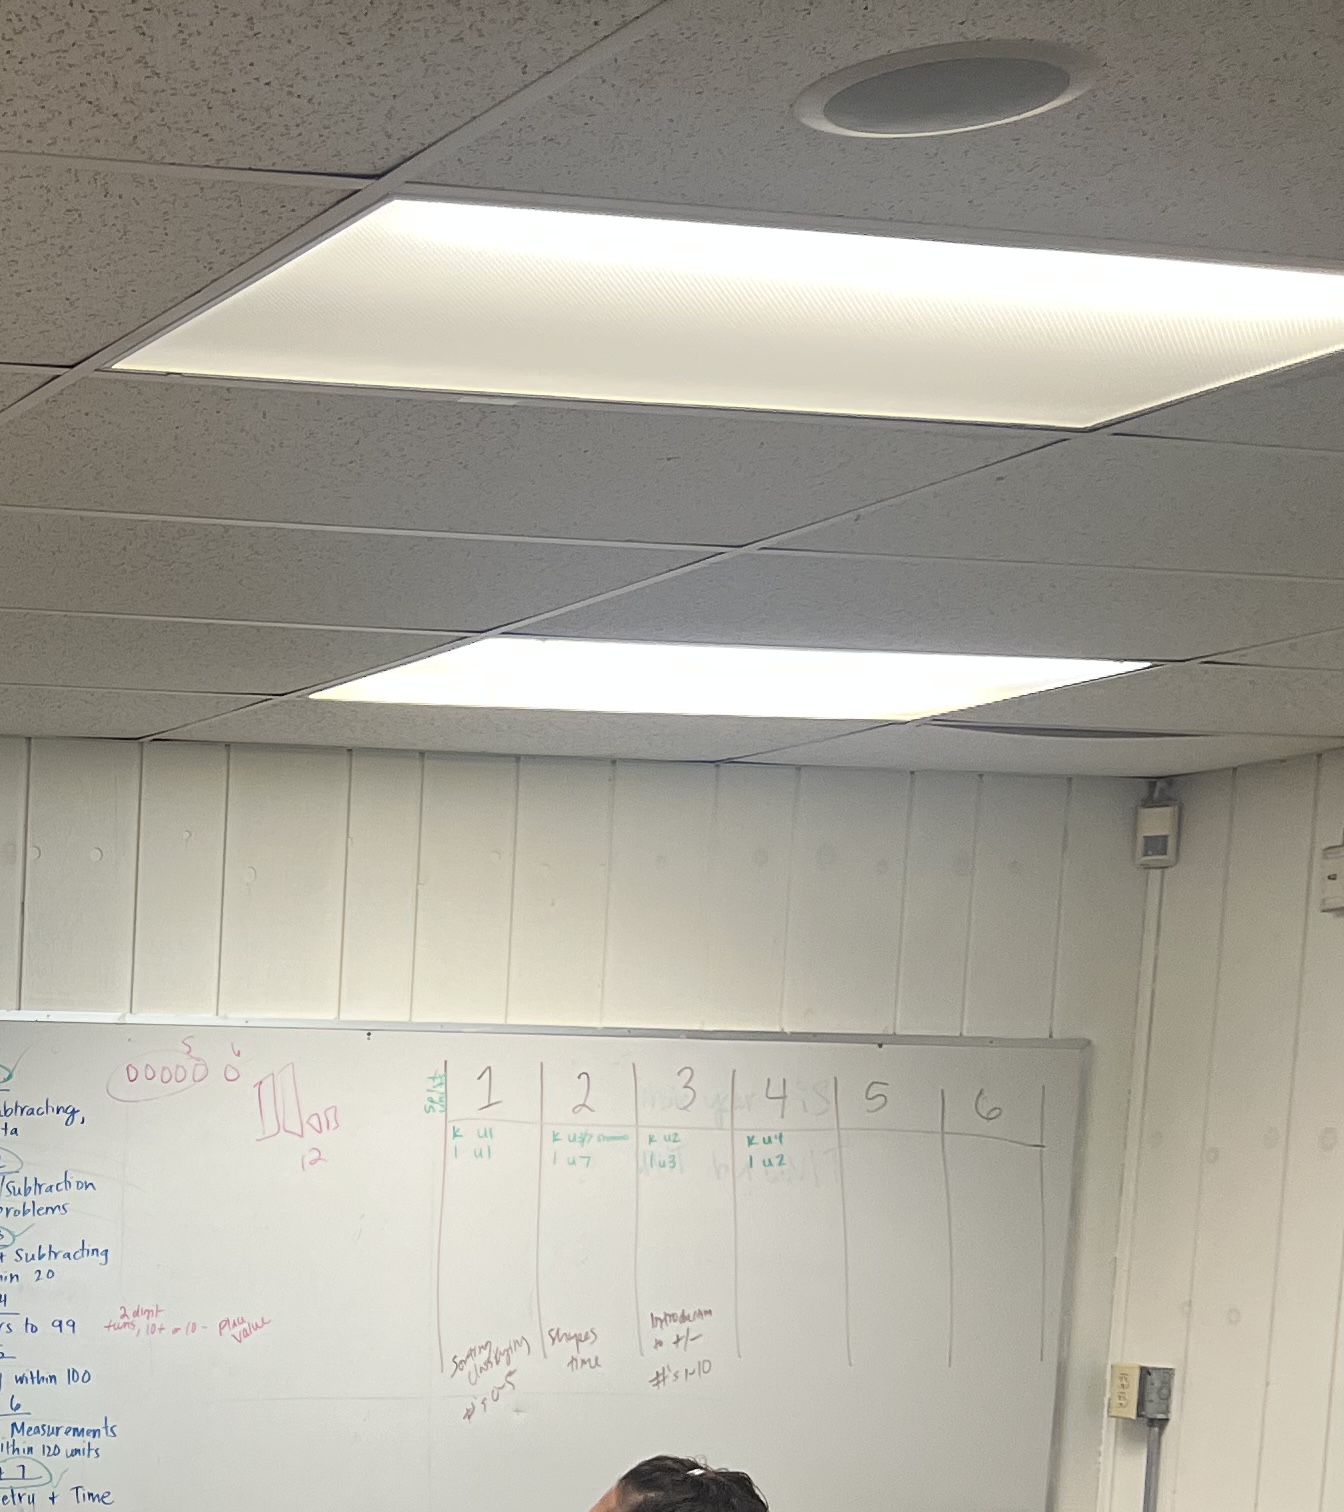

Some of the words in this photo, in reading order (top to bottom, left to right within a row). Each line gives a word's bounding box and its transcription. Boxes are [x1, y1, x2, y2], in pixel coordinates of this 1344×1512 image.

[476, 1065, 503, 1111] 1
[571, 1071, 596, 1115] 2
[676, 1066, 697, 1112] 3
[765, 1077, 788, 1119] 4
[864, 1080, 890, 1113] 5
[974, 1087, 1003, 1122] 6
[34, 1268, 55, 1283] 20
[24, 1317, 39, 1334] to
[51, 1318, 77, 1335] 99
[14, 1369, 57, 1385] within
[66, 1368, 92, 1385] 100
[9, 1394, 22, 1412] 6
[10, 1416, 119, 1440] Measurements
[41, 1443, 61, 1458] 120
[65, 1440, 101, 1459] units
[16, 1464, 27, 1480] 7
[69, 1485, 115, 1506] Time
